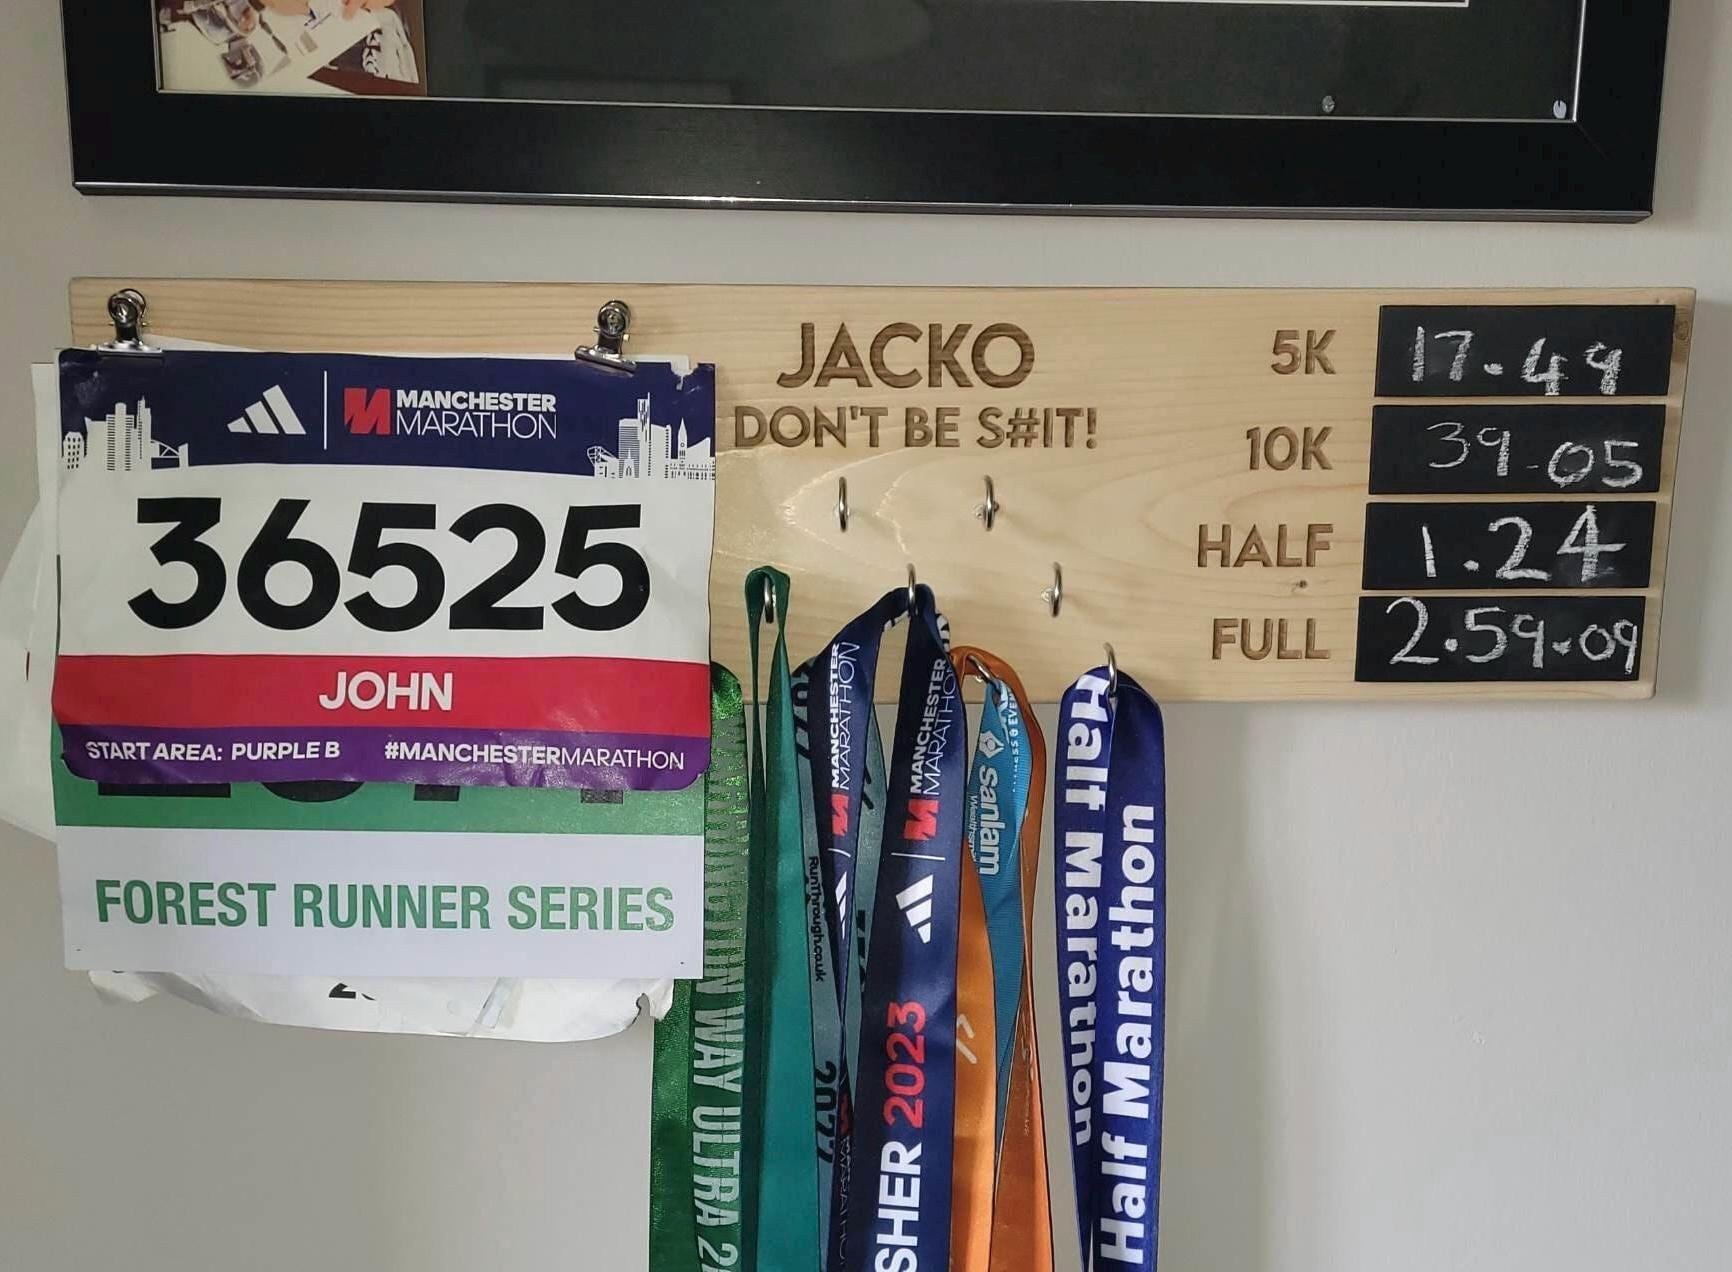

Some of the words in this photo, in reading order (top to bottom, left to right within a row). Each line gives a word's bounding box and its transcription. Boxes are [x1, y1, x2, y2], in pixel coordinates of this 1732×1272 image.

[777, 321, 1035, 389] JACKO
[1270, 328, 1337, 376] 5K
[1411, 325, 1623, 396] 17.49
[396, 389, 556, 412] MANCHESTER
[396, 410, 557, 440] MARATHON
[734, 405, 889, 448] DON'T
[904, 406, 961, 448] BE
[976, 406, 1098, 449] S#IT!
[1245, 426, 1334, 472] 10K
[127, 496, 651, 633] 36525
[1197, 523, 1334, 568] HALF
[1421, 504, 1627, 583] 1.24
[1211, 617, 1332, 661] FULL
[1385, 596, 1639, 675] 2.59.09
[318, 670, 454, 711] JOHN
[831, 643, 840, 788] MANCHESTER
[838, 641, 861, 790] MARATHON
[910, 658, 947, 794] MANCHESTER
[85, 741, 151, 761] START
[153, 742, 223, 762] AREA:
[231, 741, 321, 761] PURPLE
[324, 741, 341, 758] B
[384, 740, 685, 771] #MANCHESTERMARATHON
[979, 765, 1006, 876] sanlam
[95, 879, 277, 928] FOREST
[292, 884, 491, 931] RUNNER
[507, 886, 675, 932] SERIES
[808, 855, 827, 983] RunThrough.co.uk
[1065, 831, 1104, 1147] Marathon
[1102, 804, 1155, 1119] Marathon
[692, 1006, 746, 1094] WAY
[883, 1000, 927, 1129] 2023
[692, 1105, 742, 1227] ULTRA
[1100, 1131, 1148, 1265] Half
